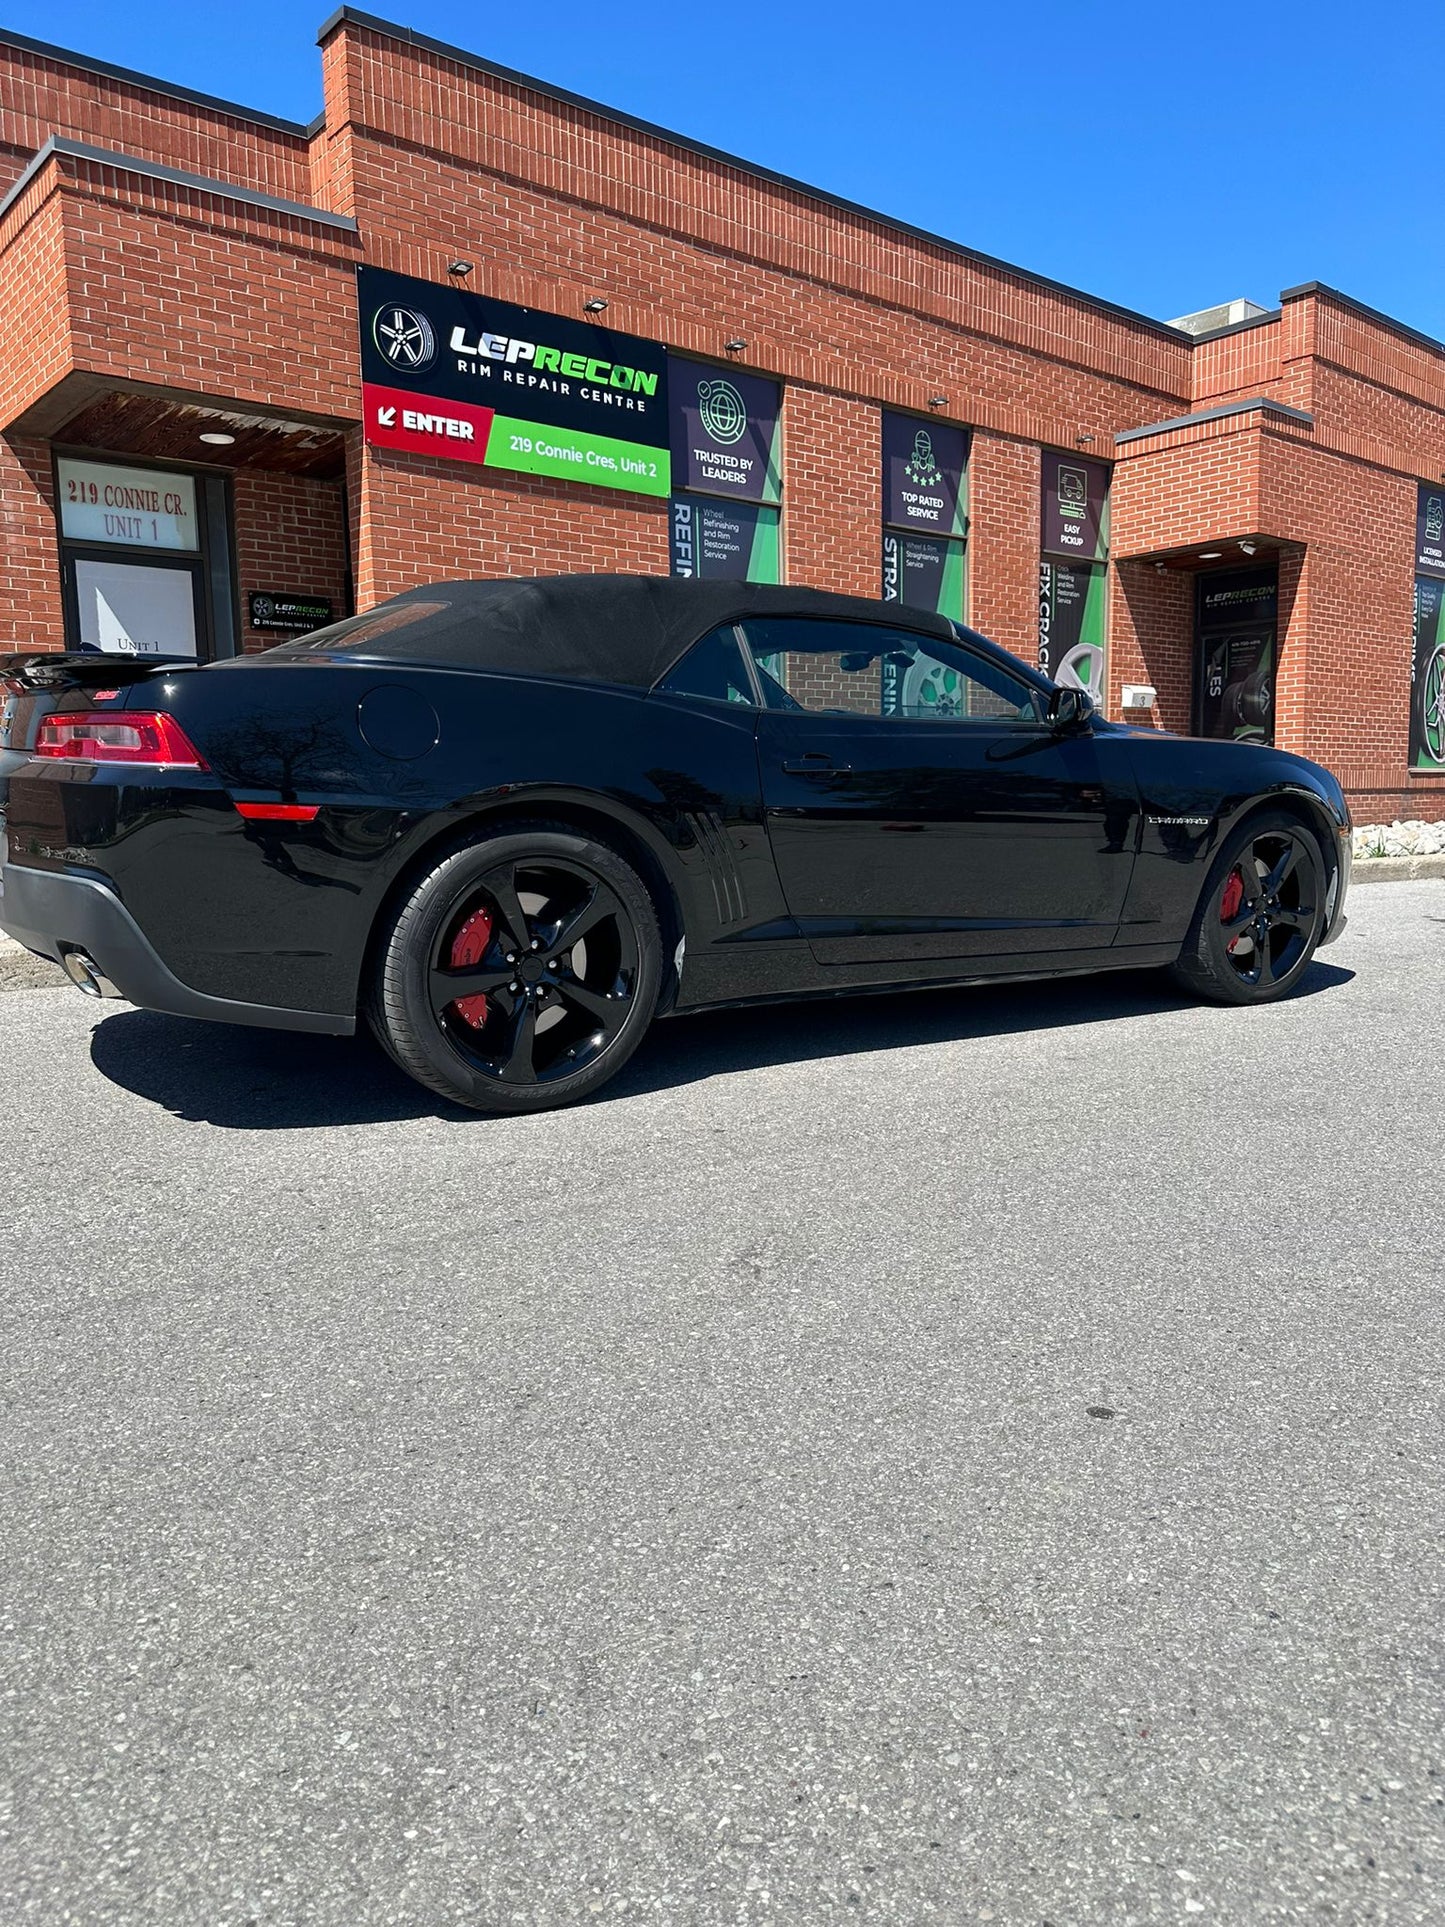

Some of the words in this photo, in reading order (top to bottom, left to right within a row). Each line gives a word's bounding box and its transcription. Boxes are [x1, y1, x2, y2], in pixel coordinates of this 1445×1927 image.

[450, 326, 658, 396] LEPRECON
[457, 359, 491, 378] RIM
[503, 370, 570, 395] REPAIR
[580, 387, 646, 412] CENTRE
[403, 410, 474, 440] ENTER
[510, 435, 533, 453] 219
[535, 440, 583, 462] Connie
[587, 452, 618, 472] Cres,
[620, 457, 647, 476] Unit
[649, 463, 657, 477] 2
[694, 449, 738, 468] TRUSTED
[740, 458, 753, 471] BY
[702, 466, 747, 484] LEADERS
[68, 480, 98, 505] 219
[104, 485, 160, 512] CONNIE
[164, 493, 187, 516] CR.
[901, 491, 918, 504] TOP
[919, 495, 944, 509] RATED
[703, 508, 725, 518] Wheel
[907, 506, 939, 521] SERVICE
[104, 514, 141, 539] UNIT
[152, 519, 158, 541] 1
[703, 519, 739, 533] Refinishing
[1064, 523, 1081, 535] EASY
[703, 530, 717, 538] and
[717, 531, 730, 540] Rim
[1060, 534, 1084, 547] PICKUP
[704, 539, 740, 552] Restoration
[704, 549, 727, 560] Service
[884, 537, 897, 602] STRA
[906, 559, 924, 569] Service
[1040, 562, 1050, 597] FIX
[1205, 585, 1275, 603] LEPRECON
[275, 603, 329, 615] LEPRECON
[154, 641, 159, 652] 1
[1139, 695, 1146, 707] 3
[1148, 816, 1208, 825] CAMARO
